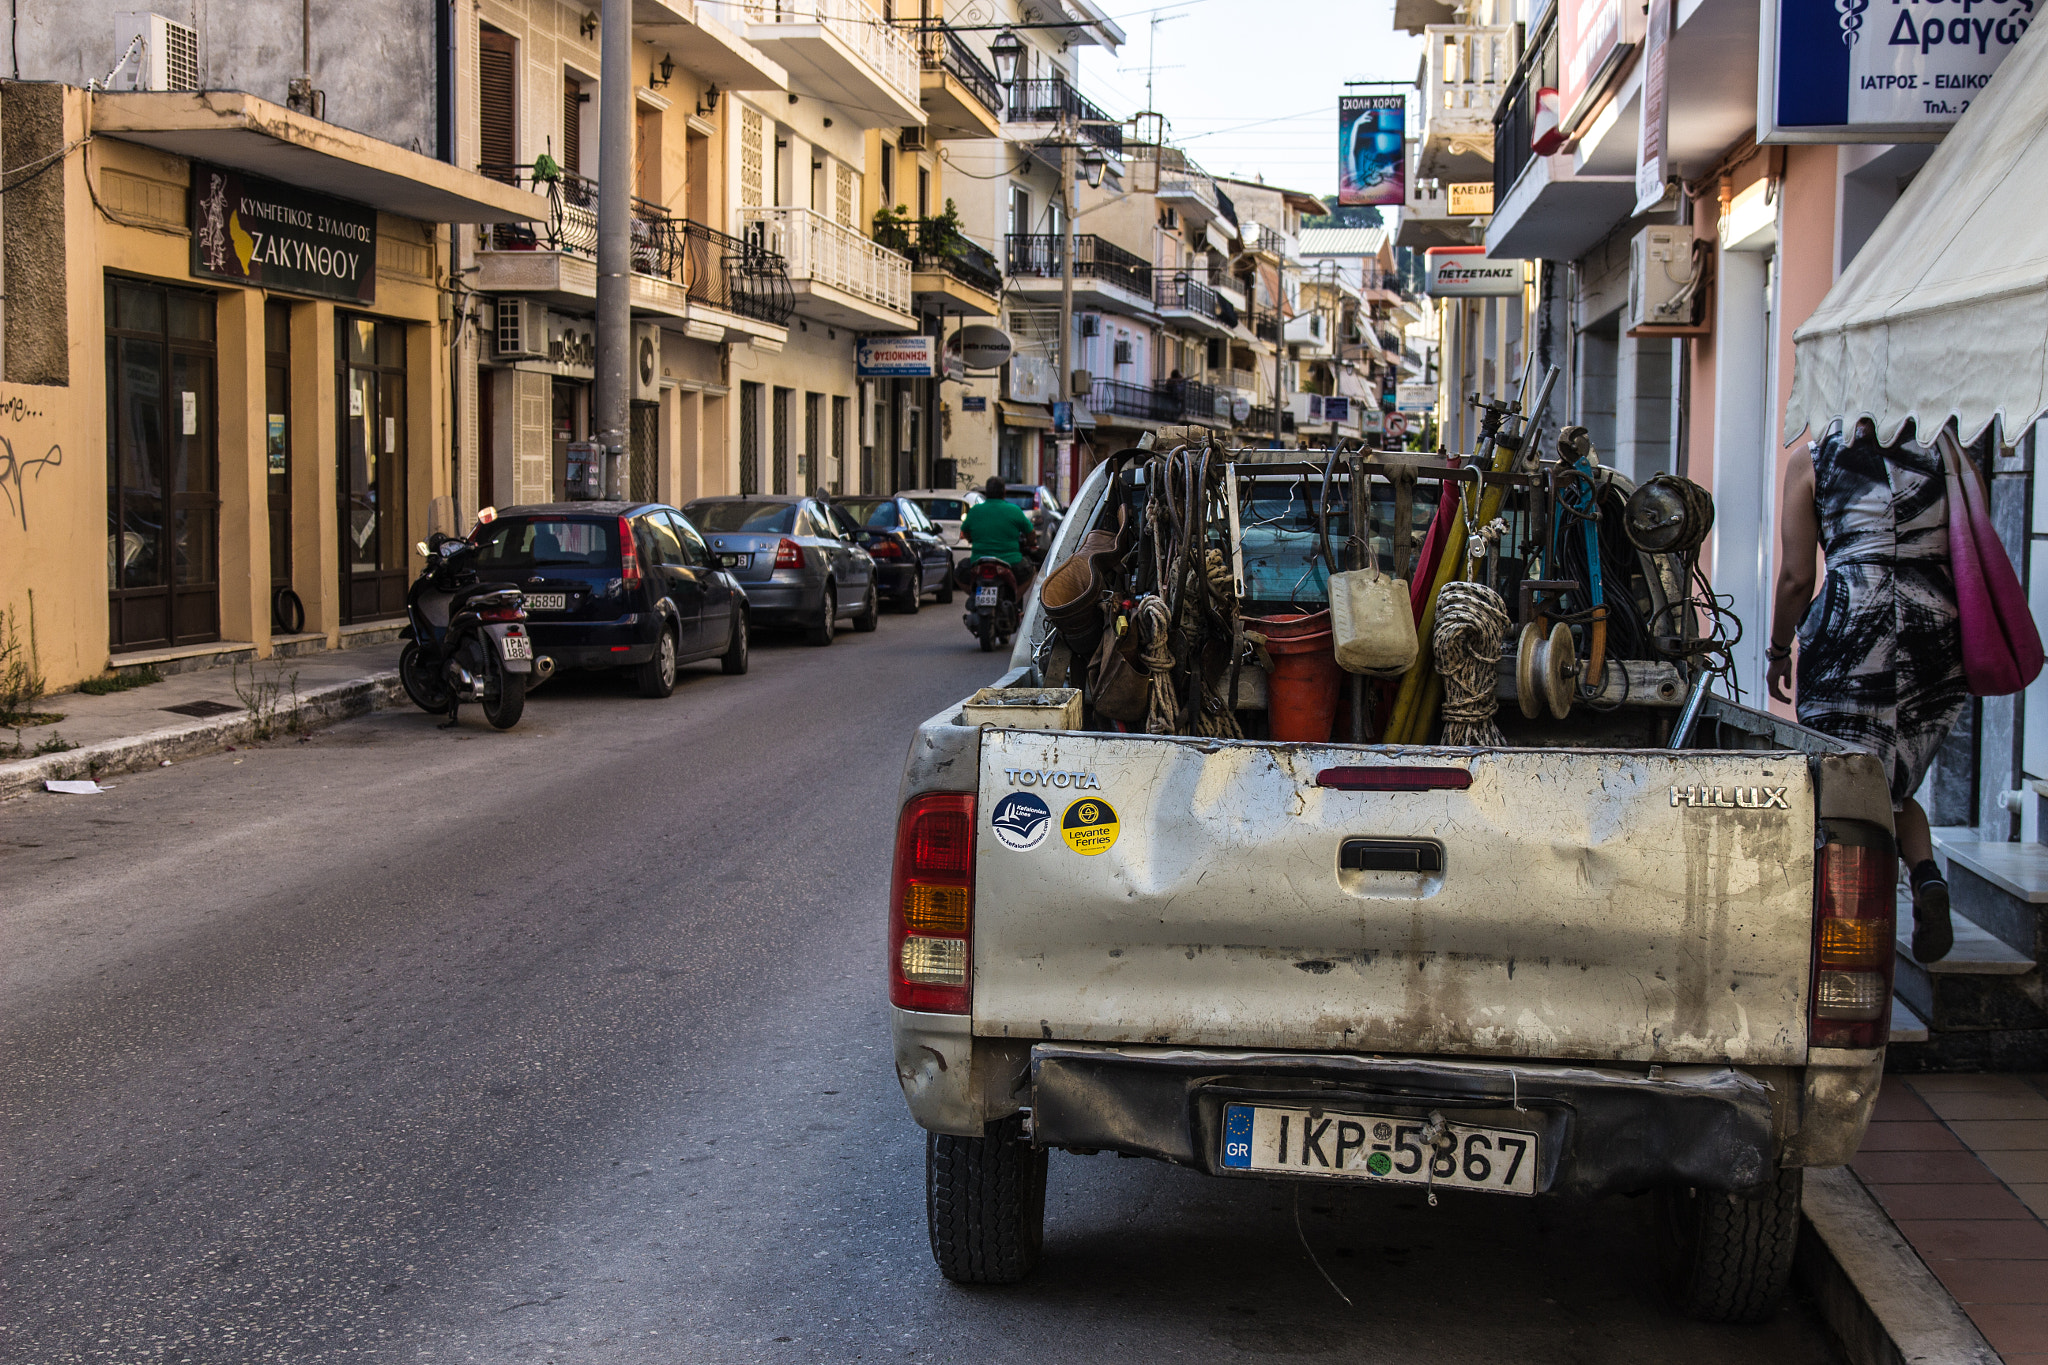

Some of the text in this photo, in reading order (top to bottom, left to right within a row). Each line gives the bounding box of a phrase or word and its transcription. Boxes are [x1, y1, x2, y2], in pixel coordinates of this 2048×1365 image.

[1888, 8, 2033, 54] Δραγώ
[1861, 75, 1918, 89] ΙΑΤΡΟΣ
[1935, 74, 1993, 89] ΕΙΔΙΚΟ
[1342, 97, 1401, 110] ΣΧΟΛΗ ΧΟΡΟΥ
[240, 197, 371, 243] ΚΥΝΗΓΕΤΙΚΟΣ ΣΥΛΛΟΓΟΣ
[250, 231, 359, 280] ΖΑΚΥΝΘΟΥ
[1438, 268, 1513, 279] ΠΕΤΖΕΤΑΚΙΣ
[981, 342, 1010, 351] moda
[874, 351, 927, 361] ΦΥΣΙΟΚΙΝΗΣΗ
[1004, 767, 1101, 790] TOYOTA
[1669, 785, 1789, 809] HILUX
[1016, 804, 1047, 815] Kefalonian
[1069, 827, 1110, 839] Levante
[1076, 836, 1111, 847] Ferries
[1227, 1143, 1248, 1157] GR
